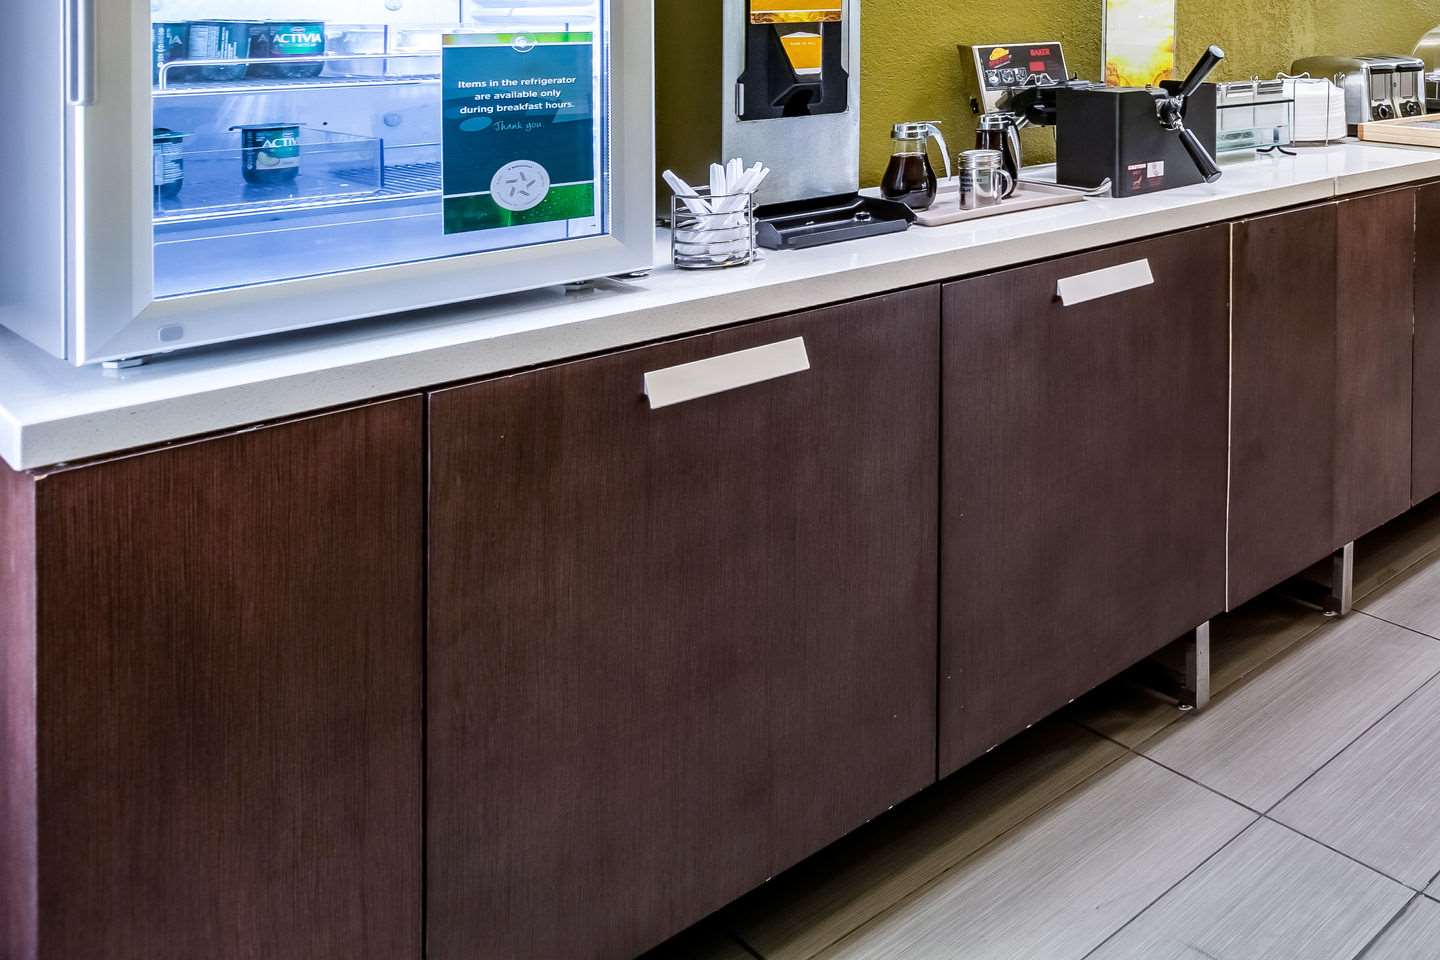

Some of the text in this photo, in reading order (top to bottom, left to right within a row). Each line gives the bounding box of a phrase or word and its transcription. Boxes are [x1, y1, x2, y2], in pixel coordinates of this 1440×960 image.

[272, 33, 322, 44] ACTIVIA
[458, 76, 576, 89] Items in the refrigerator
[474, 88, 561, 101] are available only
[460, 101, 576, 114] during breakfast hours.
[494, 120, 523, 132] Thank
